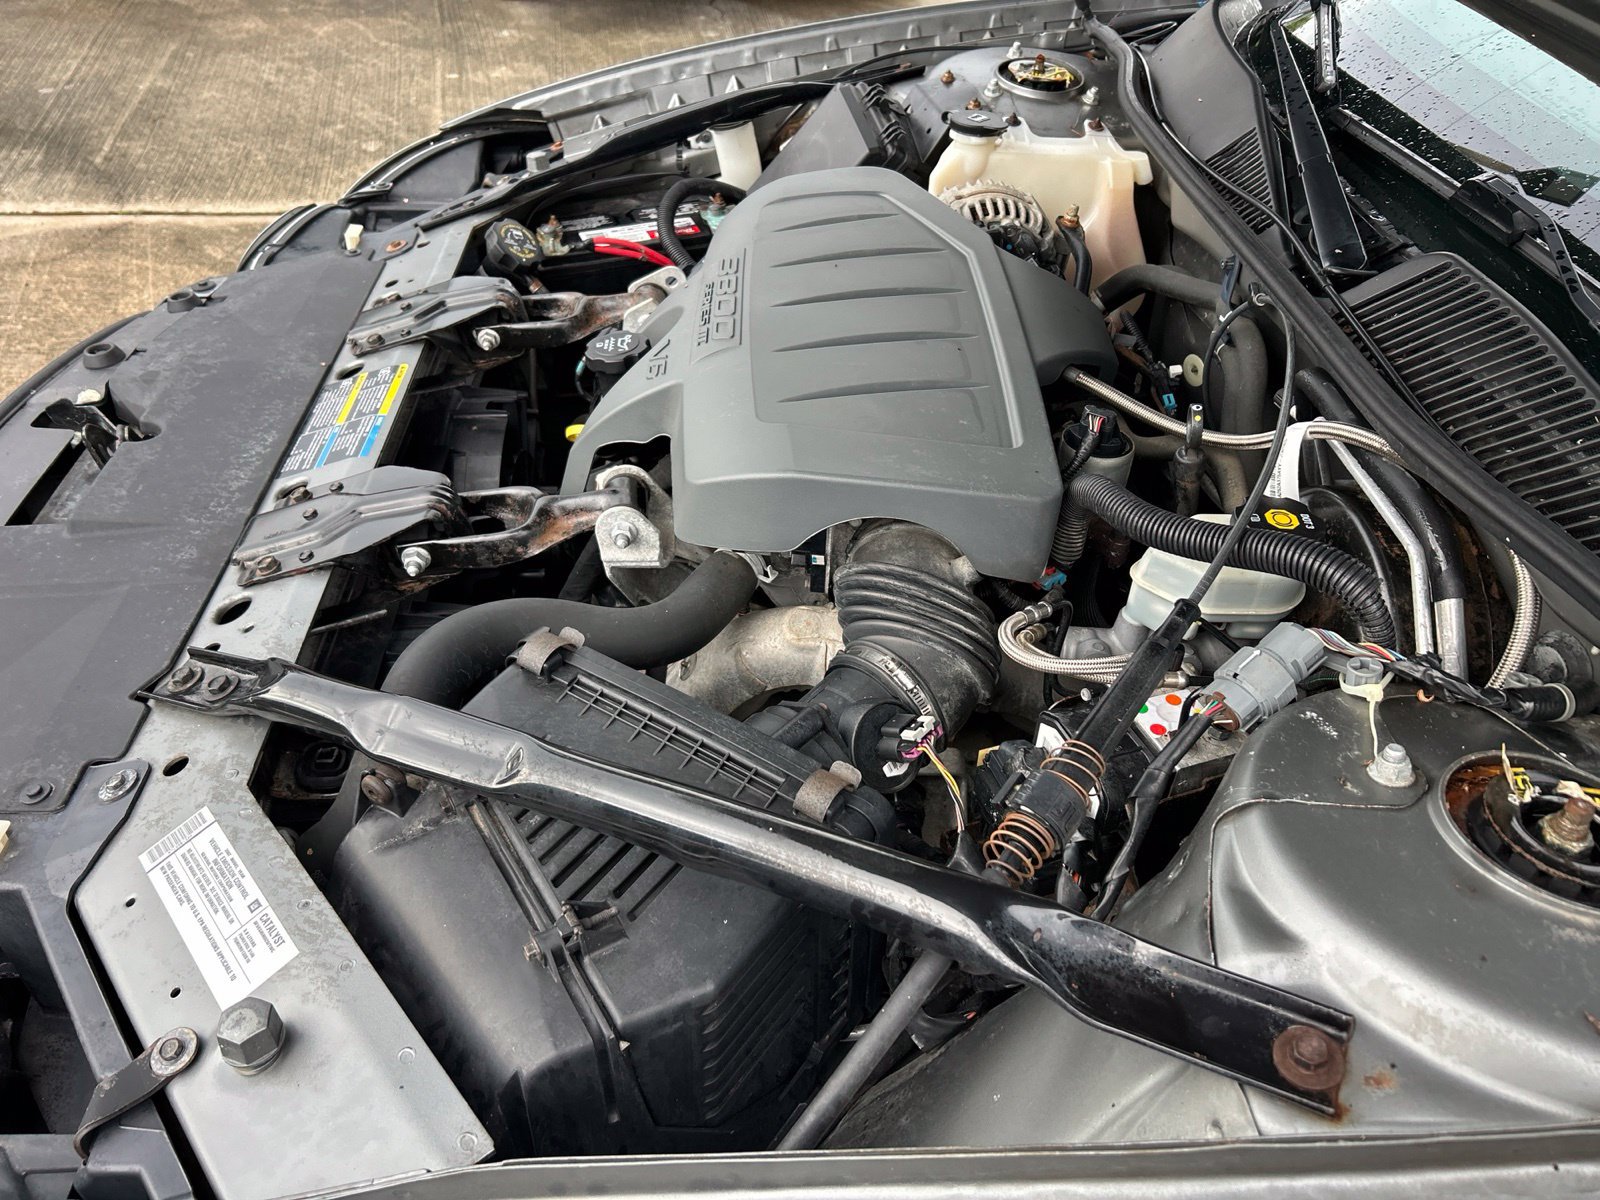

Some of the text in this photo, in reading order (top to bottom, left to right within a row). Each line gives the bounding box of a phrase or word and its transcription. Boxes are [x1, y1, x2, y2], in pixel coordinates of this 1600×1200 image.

[644, 338, 671, 381] V6
[159, 865, 167, 875] NEW
[164, 873, 179, 896] PASSENGER
[187, 864, 198, 878] MANUAL
[194, 876, 202, 884] FOR
[198, 882, 207, 894] MORE
[208, 837, 250, 900] VEHICLE EMISSION CONTROL
[211, 857, 234, 889] INFORMATION
[165, 861, 173, 870] THIS
[170, 869, 181, 885] VEHICLE
[178, 883, 193, 905] CONFORMS
[189, 903, 196, 911] TO
[197, 916, 205, 926] EPA
[201, 924, 219, 952] REGULATIONS
[216, 950, 232, 975] APPLICABLE
[229, 973, 236, 982] TO
[212, 892, 223, 906] SERVICE
[220, 905, 231, 919] MANUAL
[259, 912, 285, 948] CATALYST
